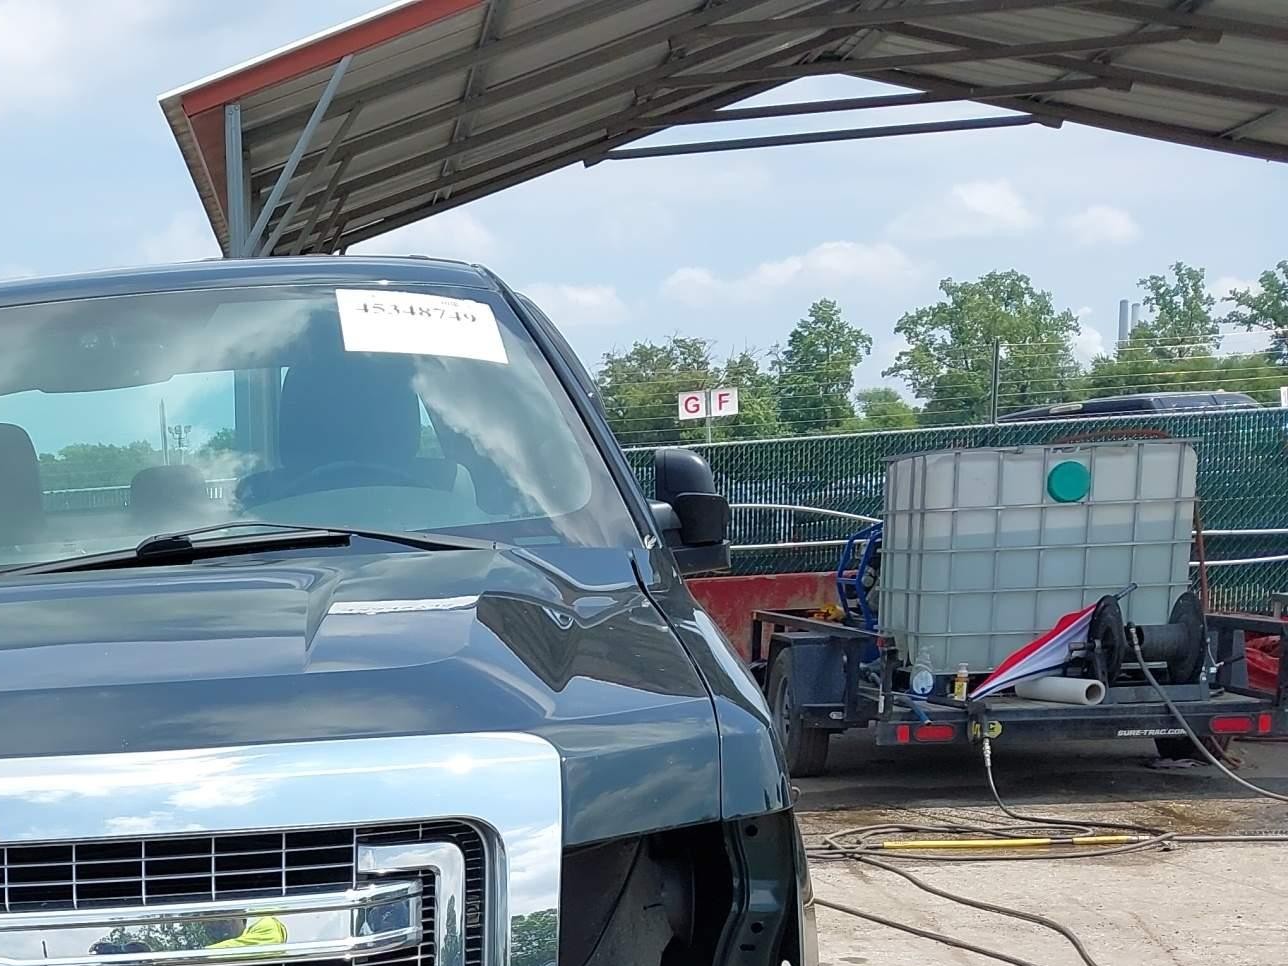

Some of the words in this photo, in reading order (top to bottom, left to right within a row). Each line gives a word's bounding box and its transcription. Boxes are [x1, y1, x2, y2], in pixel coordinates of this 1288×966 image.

[356, 303, 476, 322] 45348749
[684, 396, 700, 413] G
[718, 393, 730, 411] F
